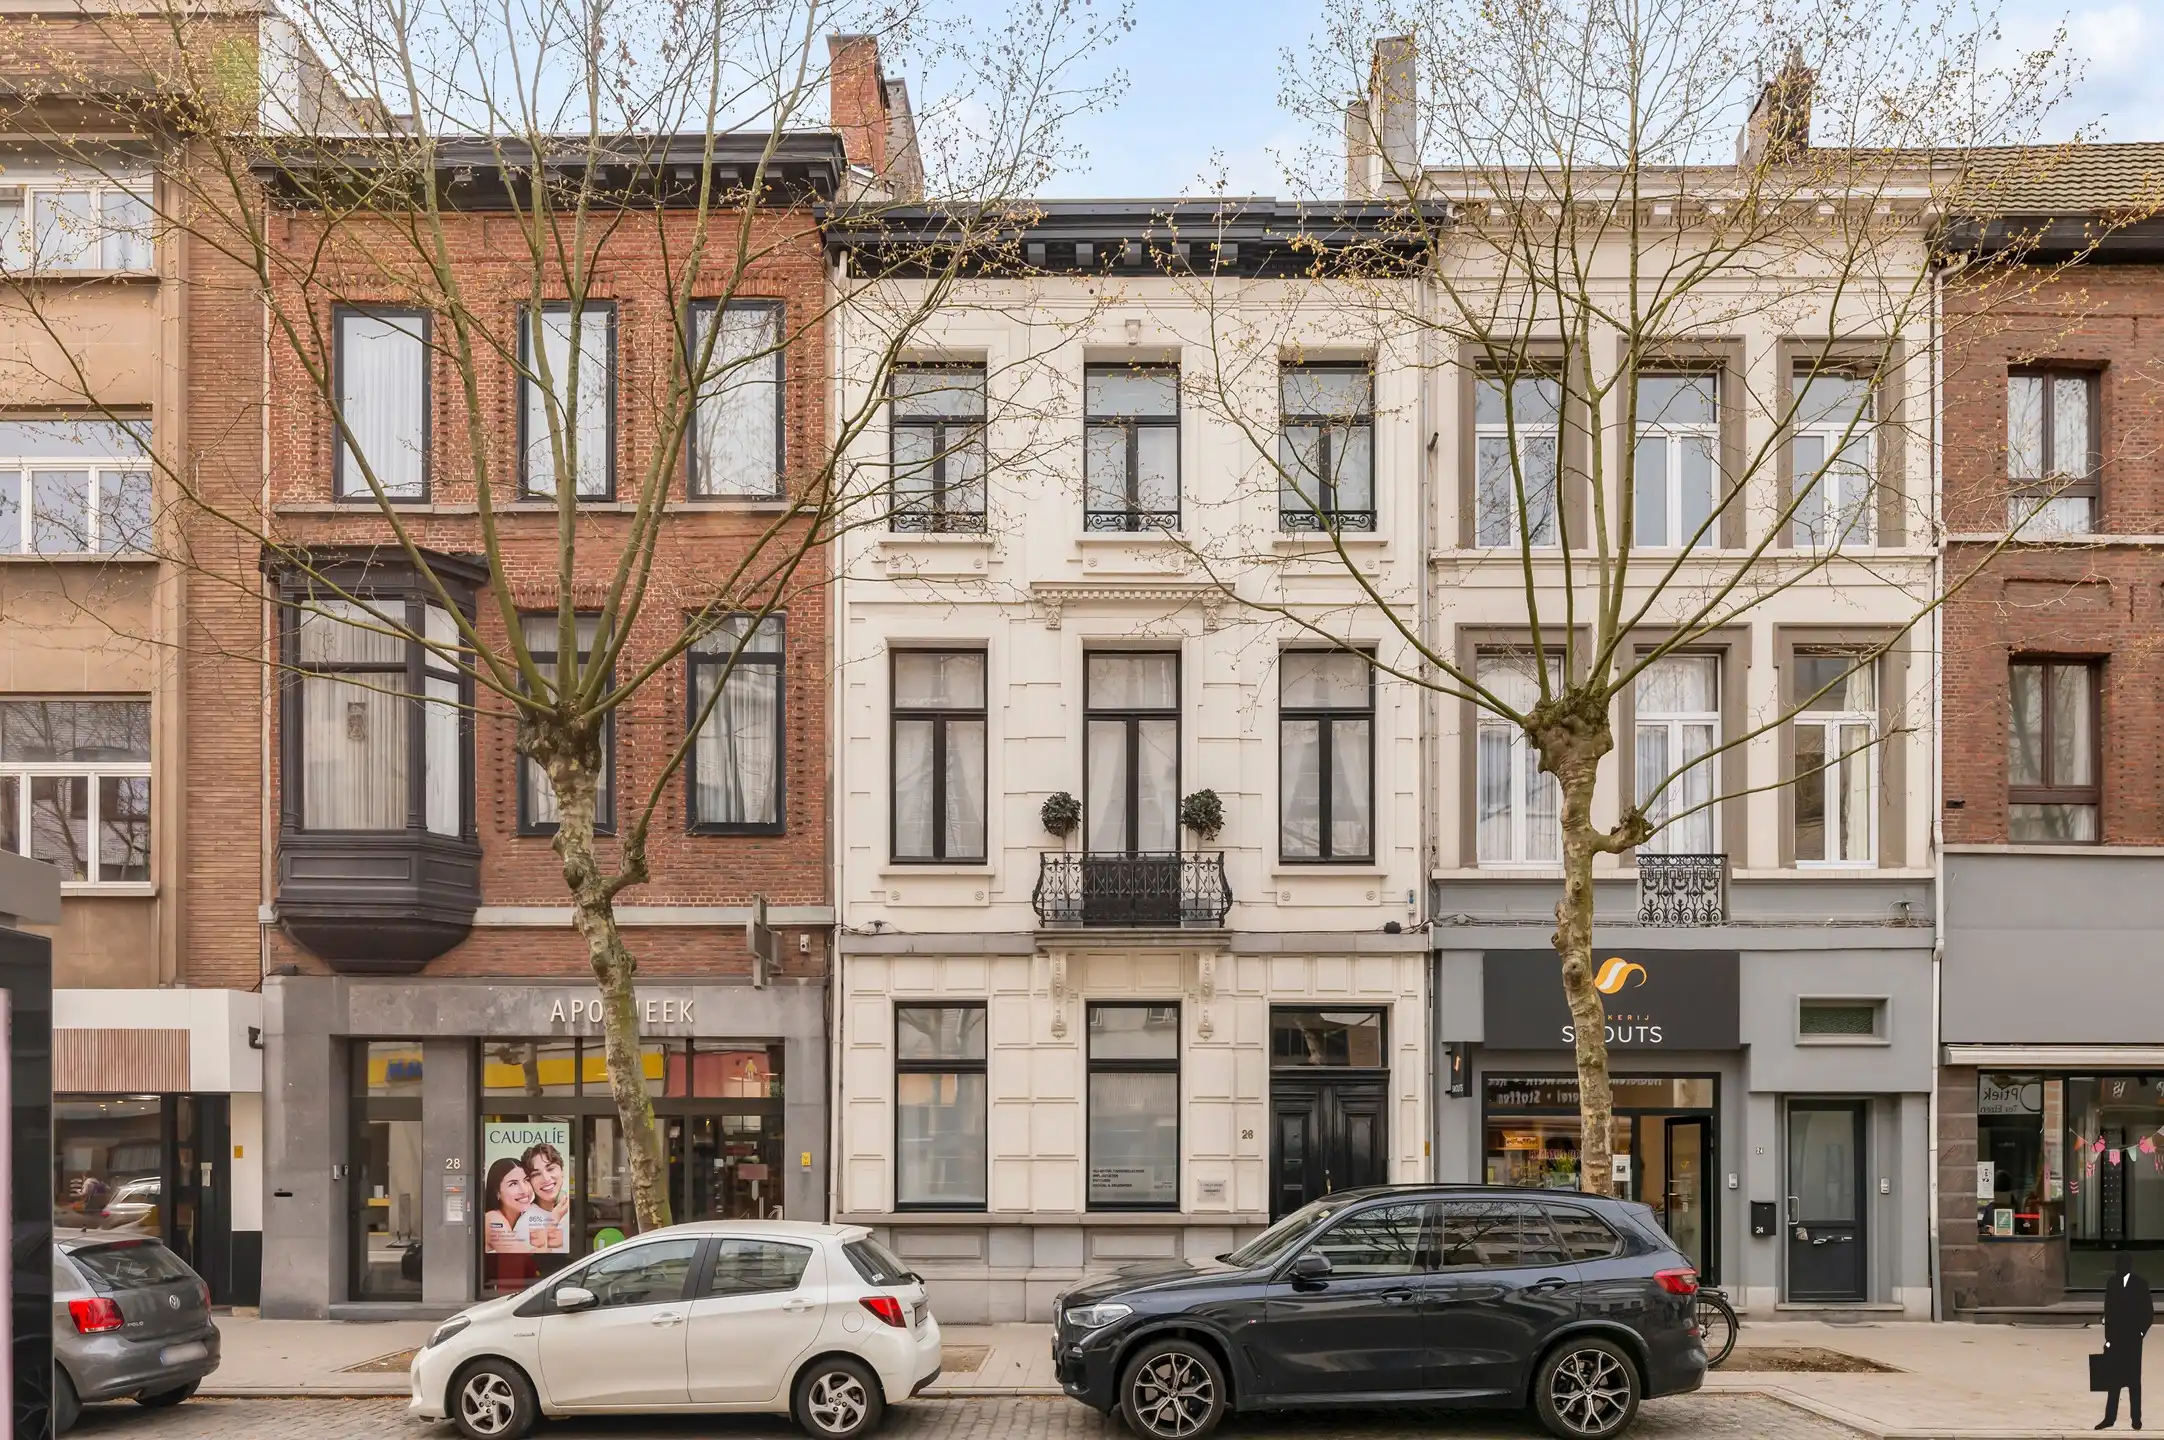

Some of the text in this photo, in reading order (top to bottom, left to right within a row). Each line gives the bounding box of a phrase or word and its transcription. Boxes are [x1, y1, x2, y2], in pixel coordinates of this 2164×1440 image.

[550, 999, 694, 1023] APOEEK
[1562, 1025, 1663, 1043] SOUTS
[489, 1127, 565, 1144] CAUDALÍE
[1241, 1129, 1254, 1140] 26
[445, 1158, 461, 1170] 28
[1756, 1226, 1764, 1234] 24
